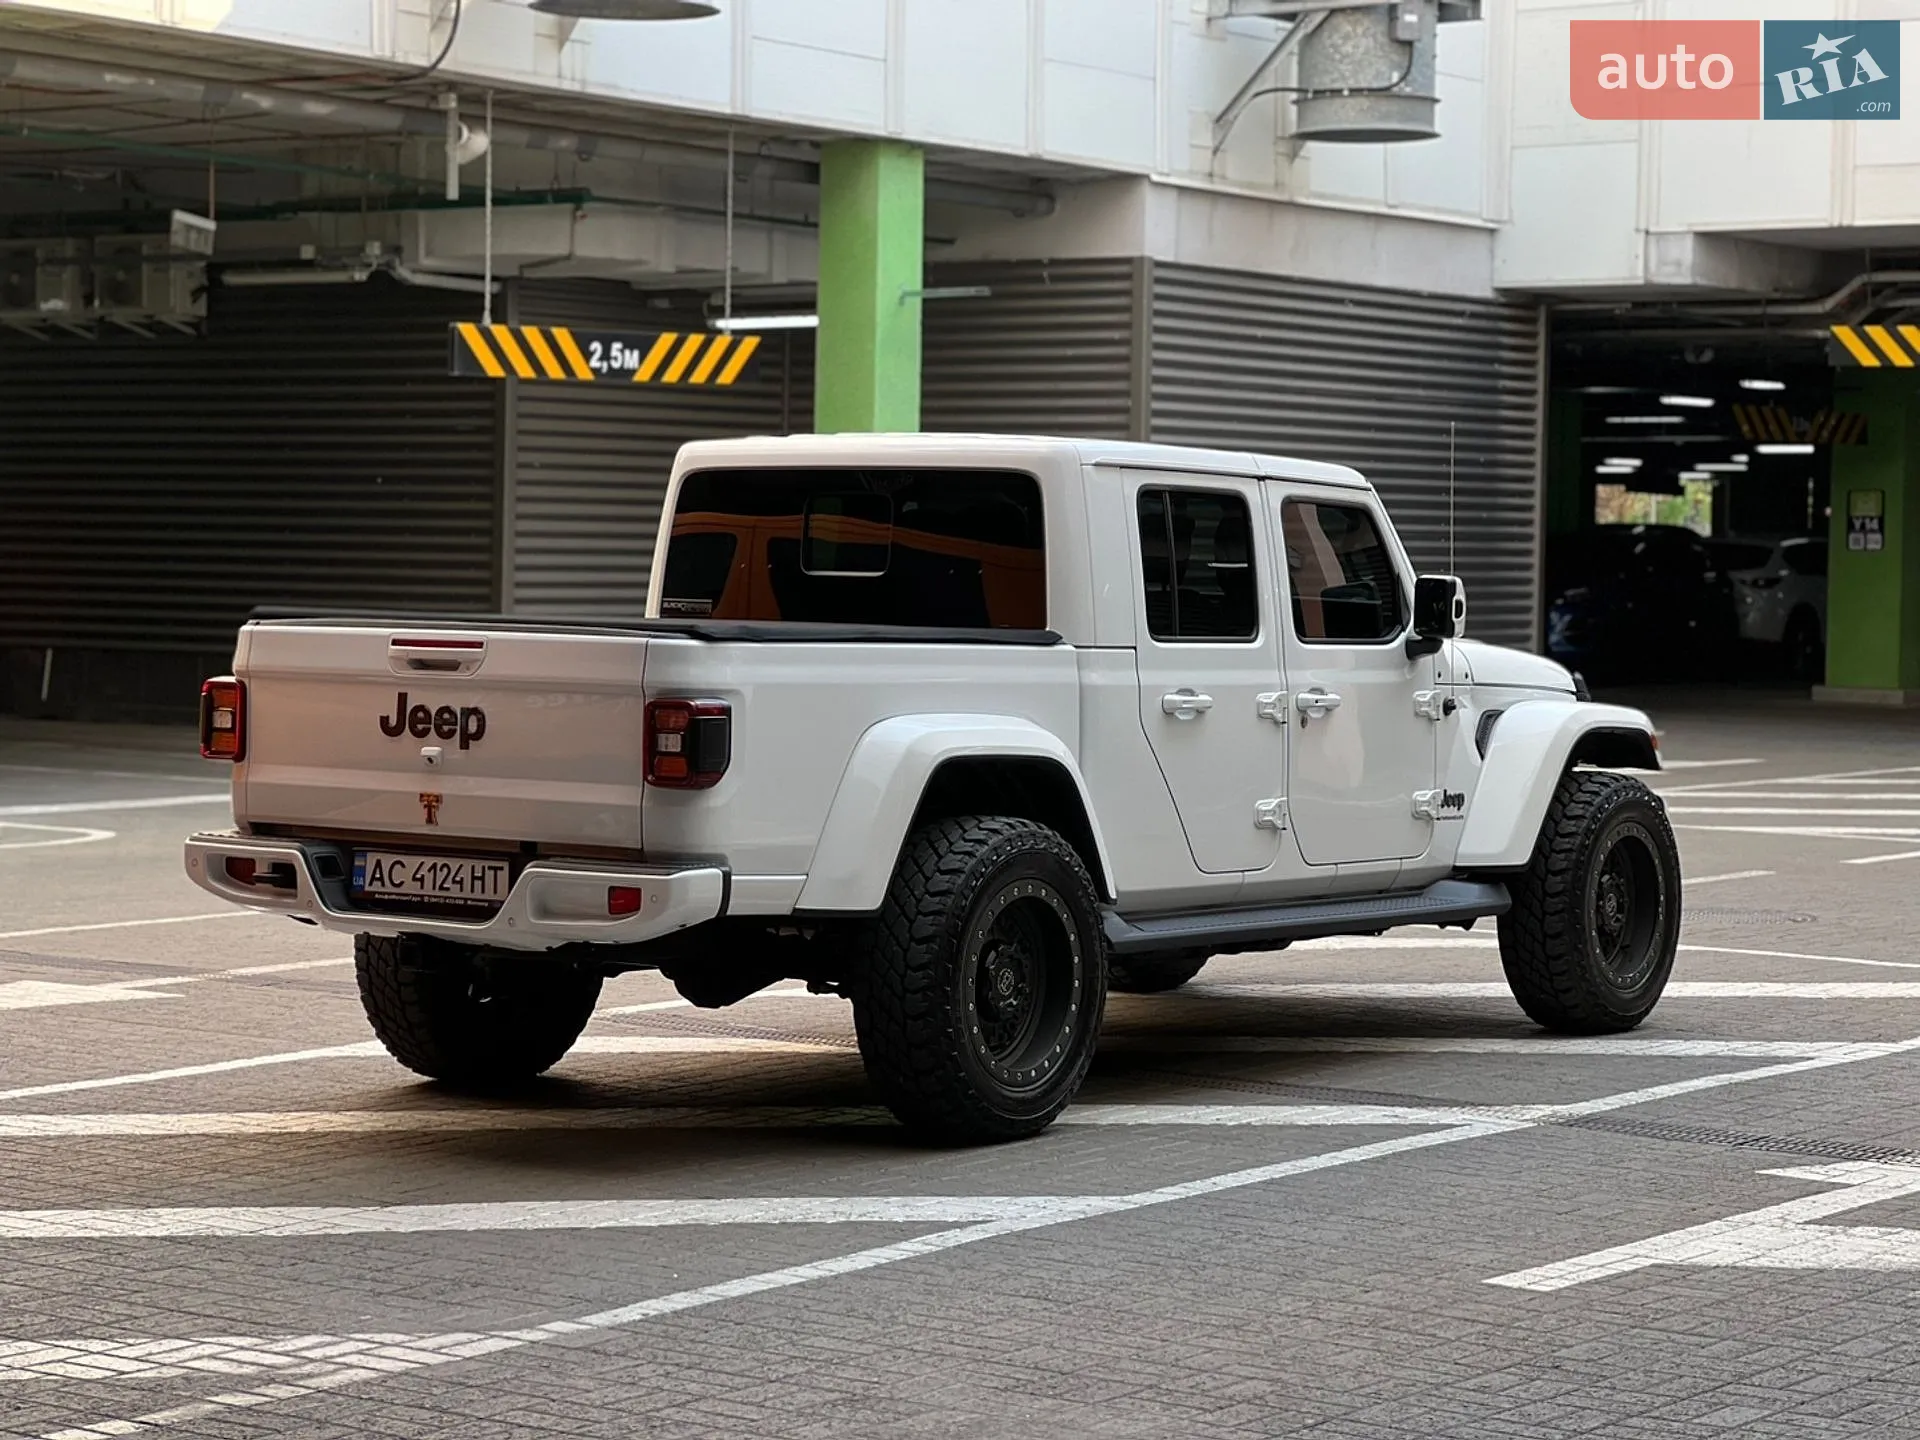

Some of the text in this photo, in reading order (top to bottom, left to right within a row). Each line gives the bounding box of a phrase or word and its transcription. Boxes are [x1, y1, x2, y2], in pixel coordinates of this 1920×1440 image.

[379, 692, 486, 750] Jeep
[1441, 789, 1465, 811] Jeep
[352, 875, 365, 887] UA
[368, 858, 505, 895] AC 4124 HT
